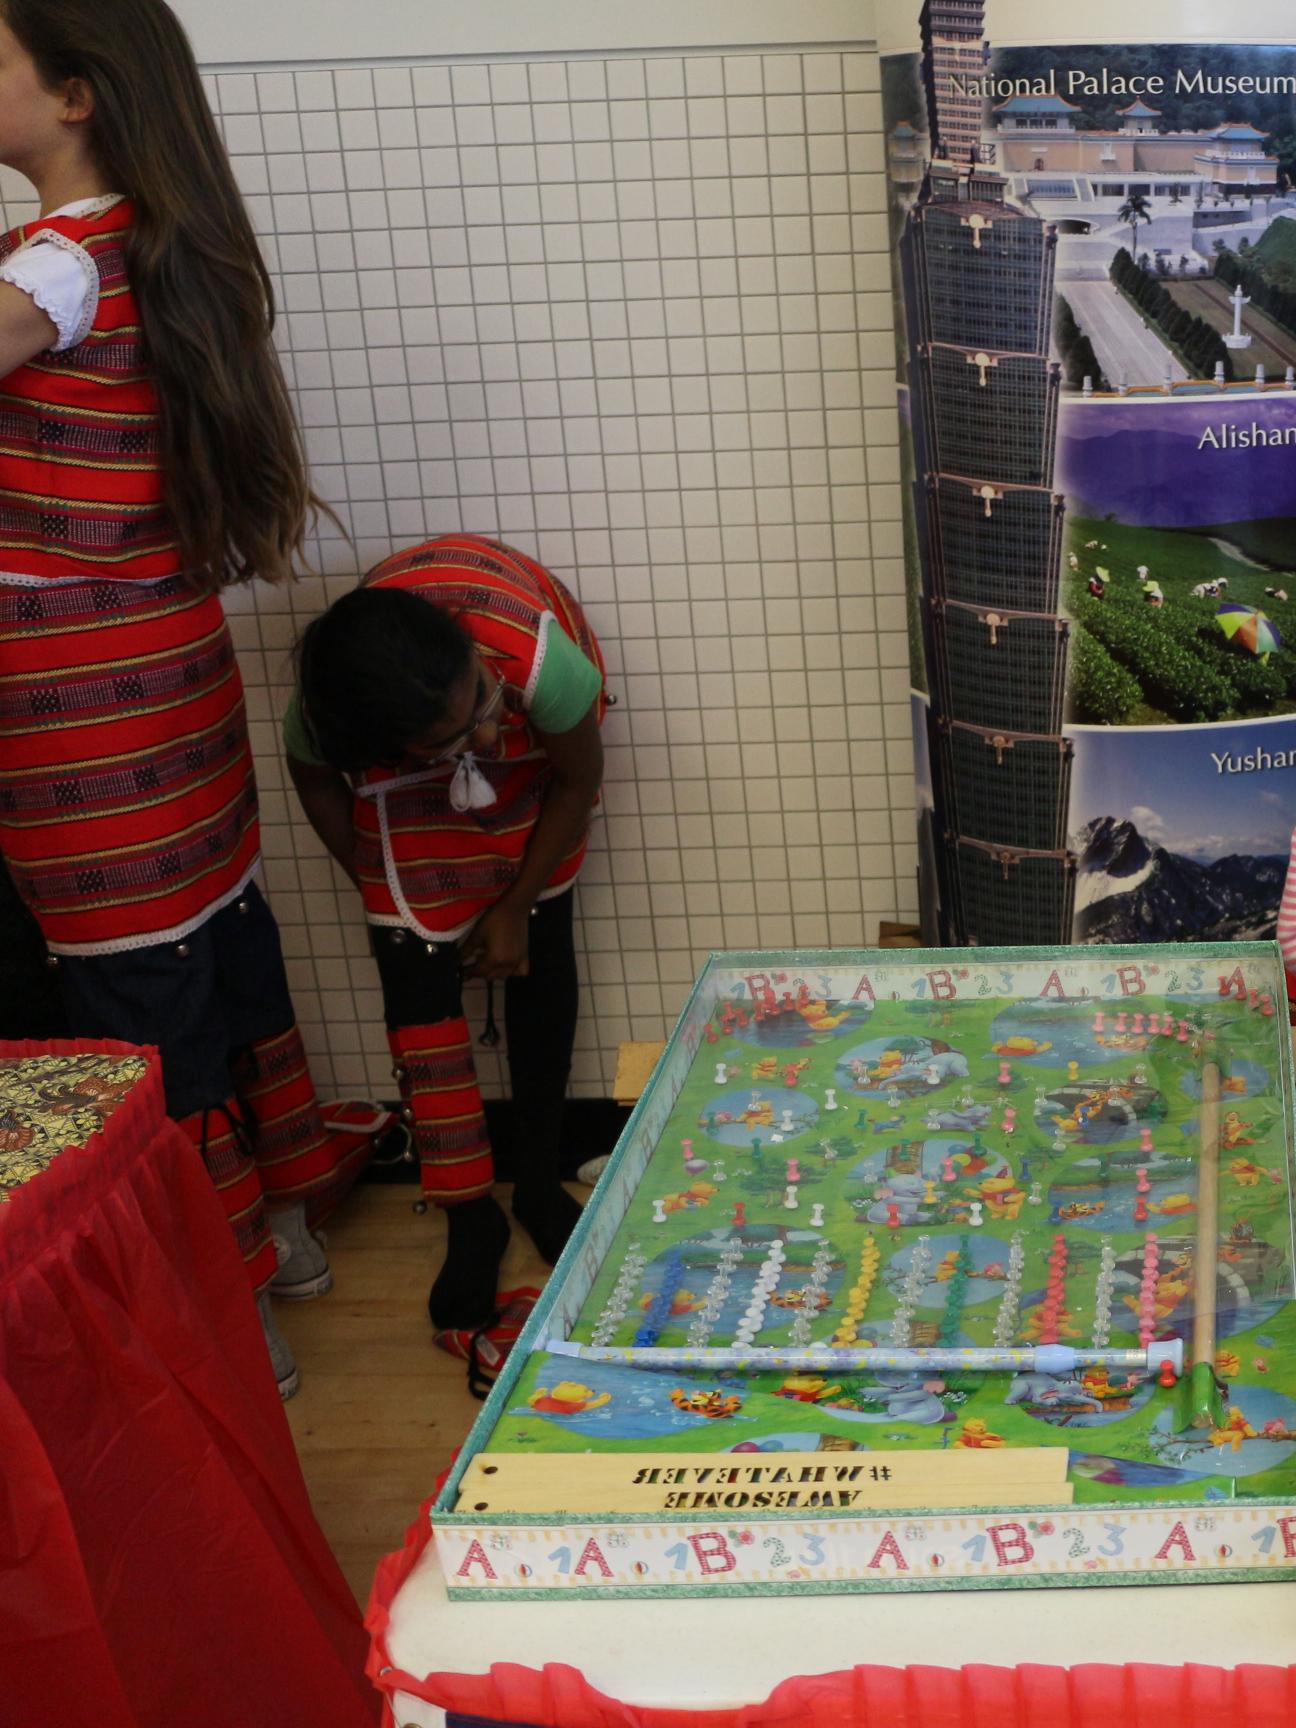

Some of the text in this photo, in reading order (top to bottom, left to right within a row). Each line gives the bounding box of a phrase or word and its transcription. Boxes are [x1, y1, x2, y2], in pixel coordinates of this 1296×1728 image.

[949, 67, 1296, 98] National Palace Museum
[664, 1489, 863, 1509] AWESOME
